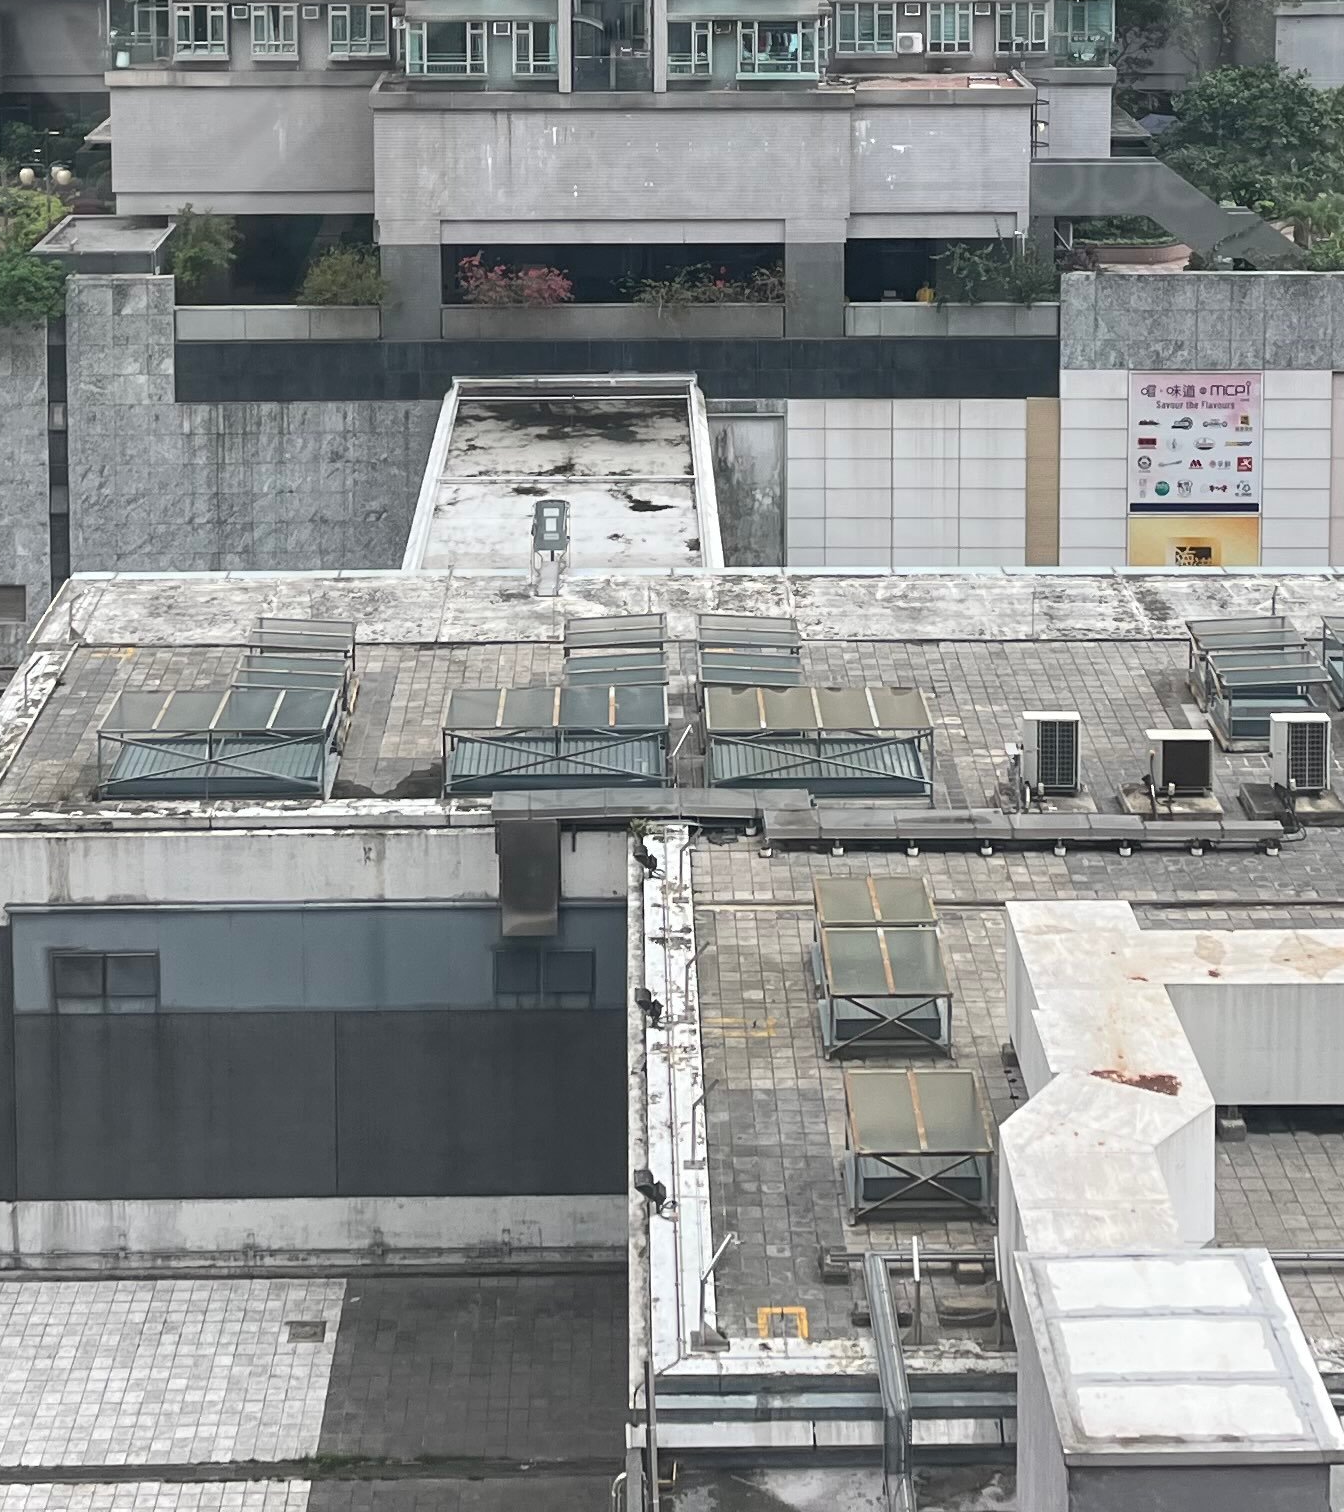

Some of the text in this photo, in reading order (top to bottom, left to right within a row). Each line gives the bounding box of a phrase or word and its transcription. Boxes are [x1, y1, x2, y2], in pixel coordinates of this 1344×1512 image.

[1156, 400, 1235, 410] Savour the Flavours
